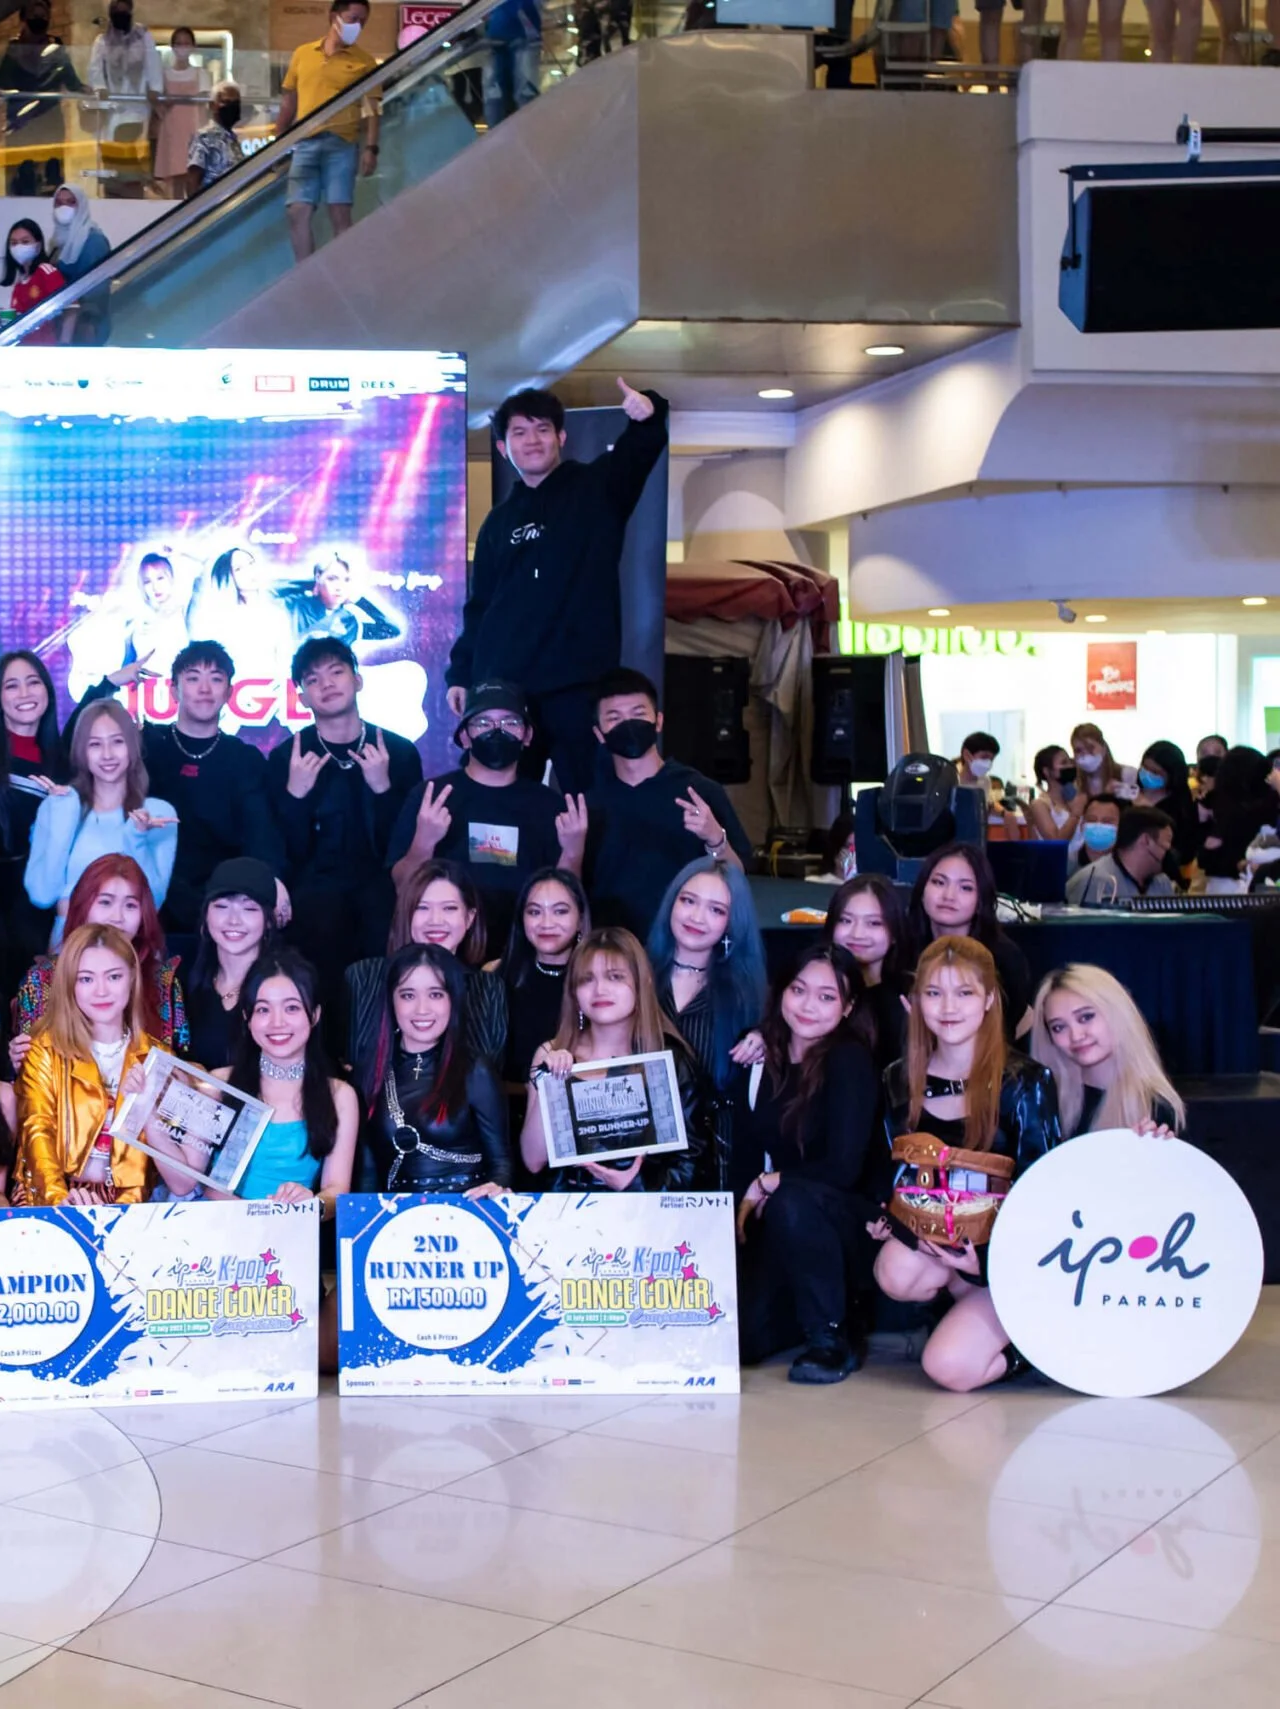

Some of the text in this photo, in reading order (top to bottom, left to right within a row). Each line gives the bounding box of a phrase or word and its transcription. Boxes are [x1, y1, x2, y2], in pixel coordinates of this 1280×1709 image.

[310, 379, 348, 390] DRUM
[598, 1118, 650, 1132] RUNNER-UP
[414, 1235, 458, 1252] 2ND
[1037, 1210, 1210, 1307] ipoh
[370, 1261, 503, 1279] RUNNER UP
[561, 1278, 710, 1310] DANCE COVER
[147, 1284, 292, 1321] DANCE COVER
[1102, 1295, 1203, 1308] PARADE
[263, 1382, 295, 1393] ARA
[346, 1380, 375, 1388] Sponsors
[684, 1376, 716, 1386] ARA
